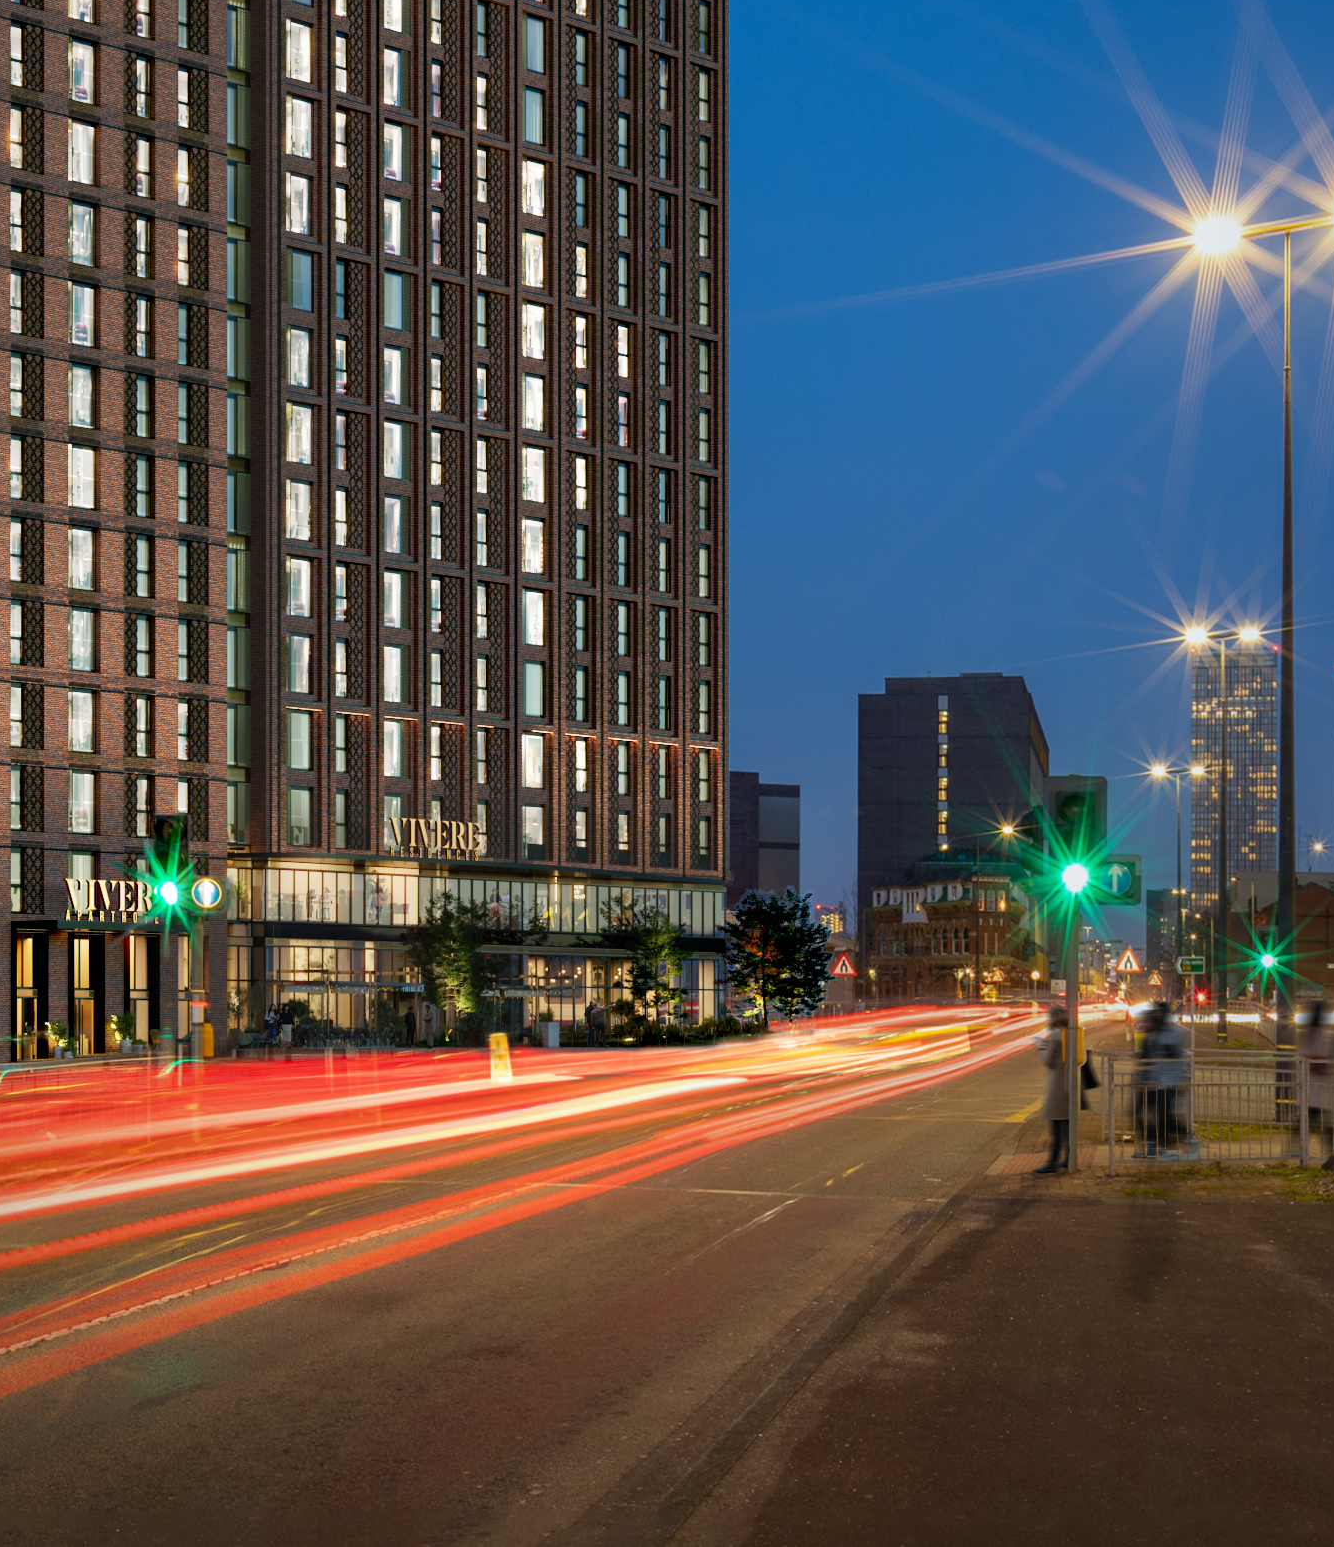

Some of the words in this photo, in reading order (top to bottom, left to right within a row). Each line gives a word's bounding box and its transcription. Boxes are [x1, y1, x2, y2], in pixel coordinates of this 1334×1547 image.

[389, 817, 480, 851] VIVERE
[390, 846, 479, 862] RESIDENCES
[65, 878, 170, 912] VIVER
